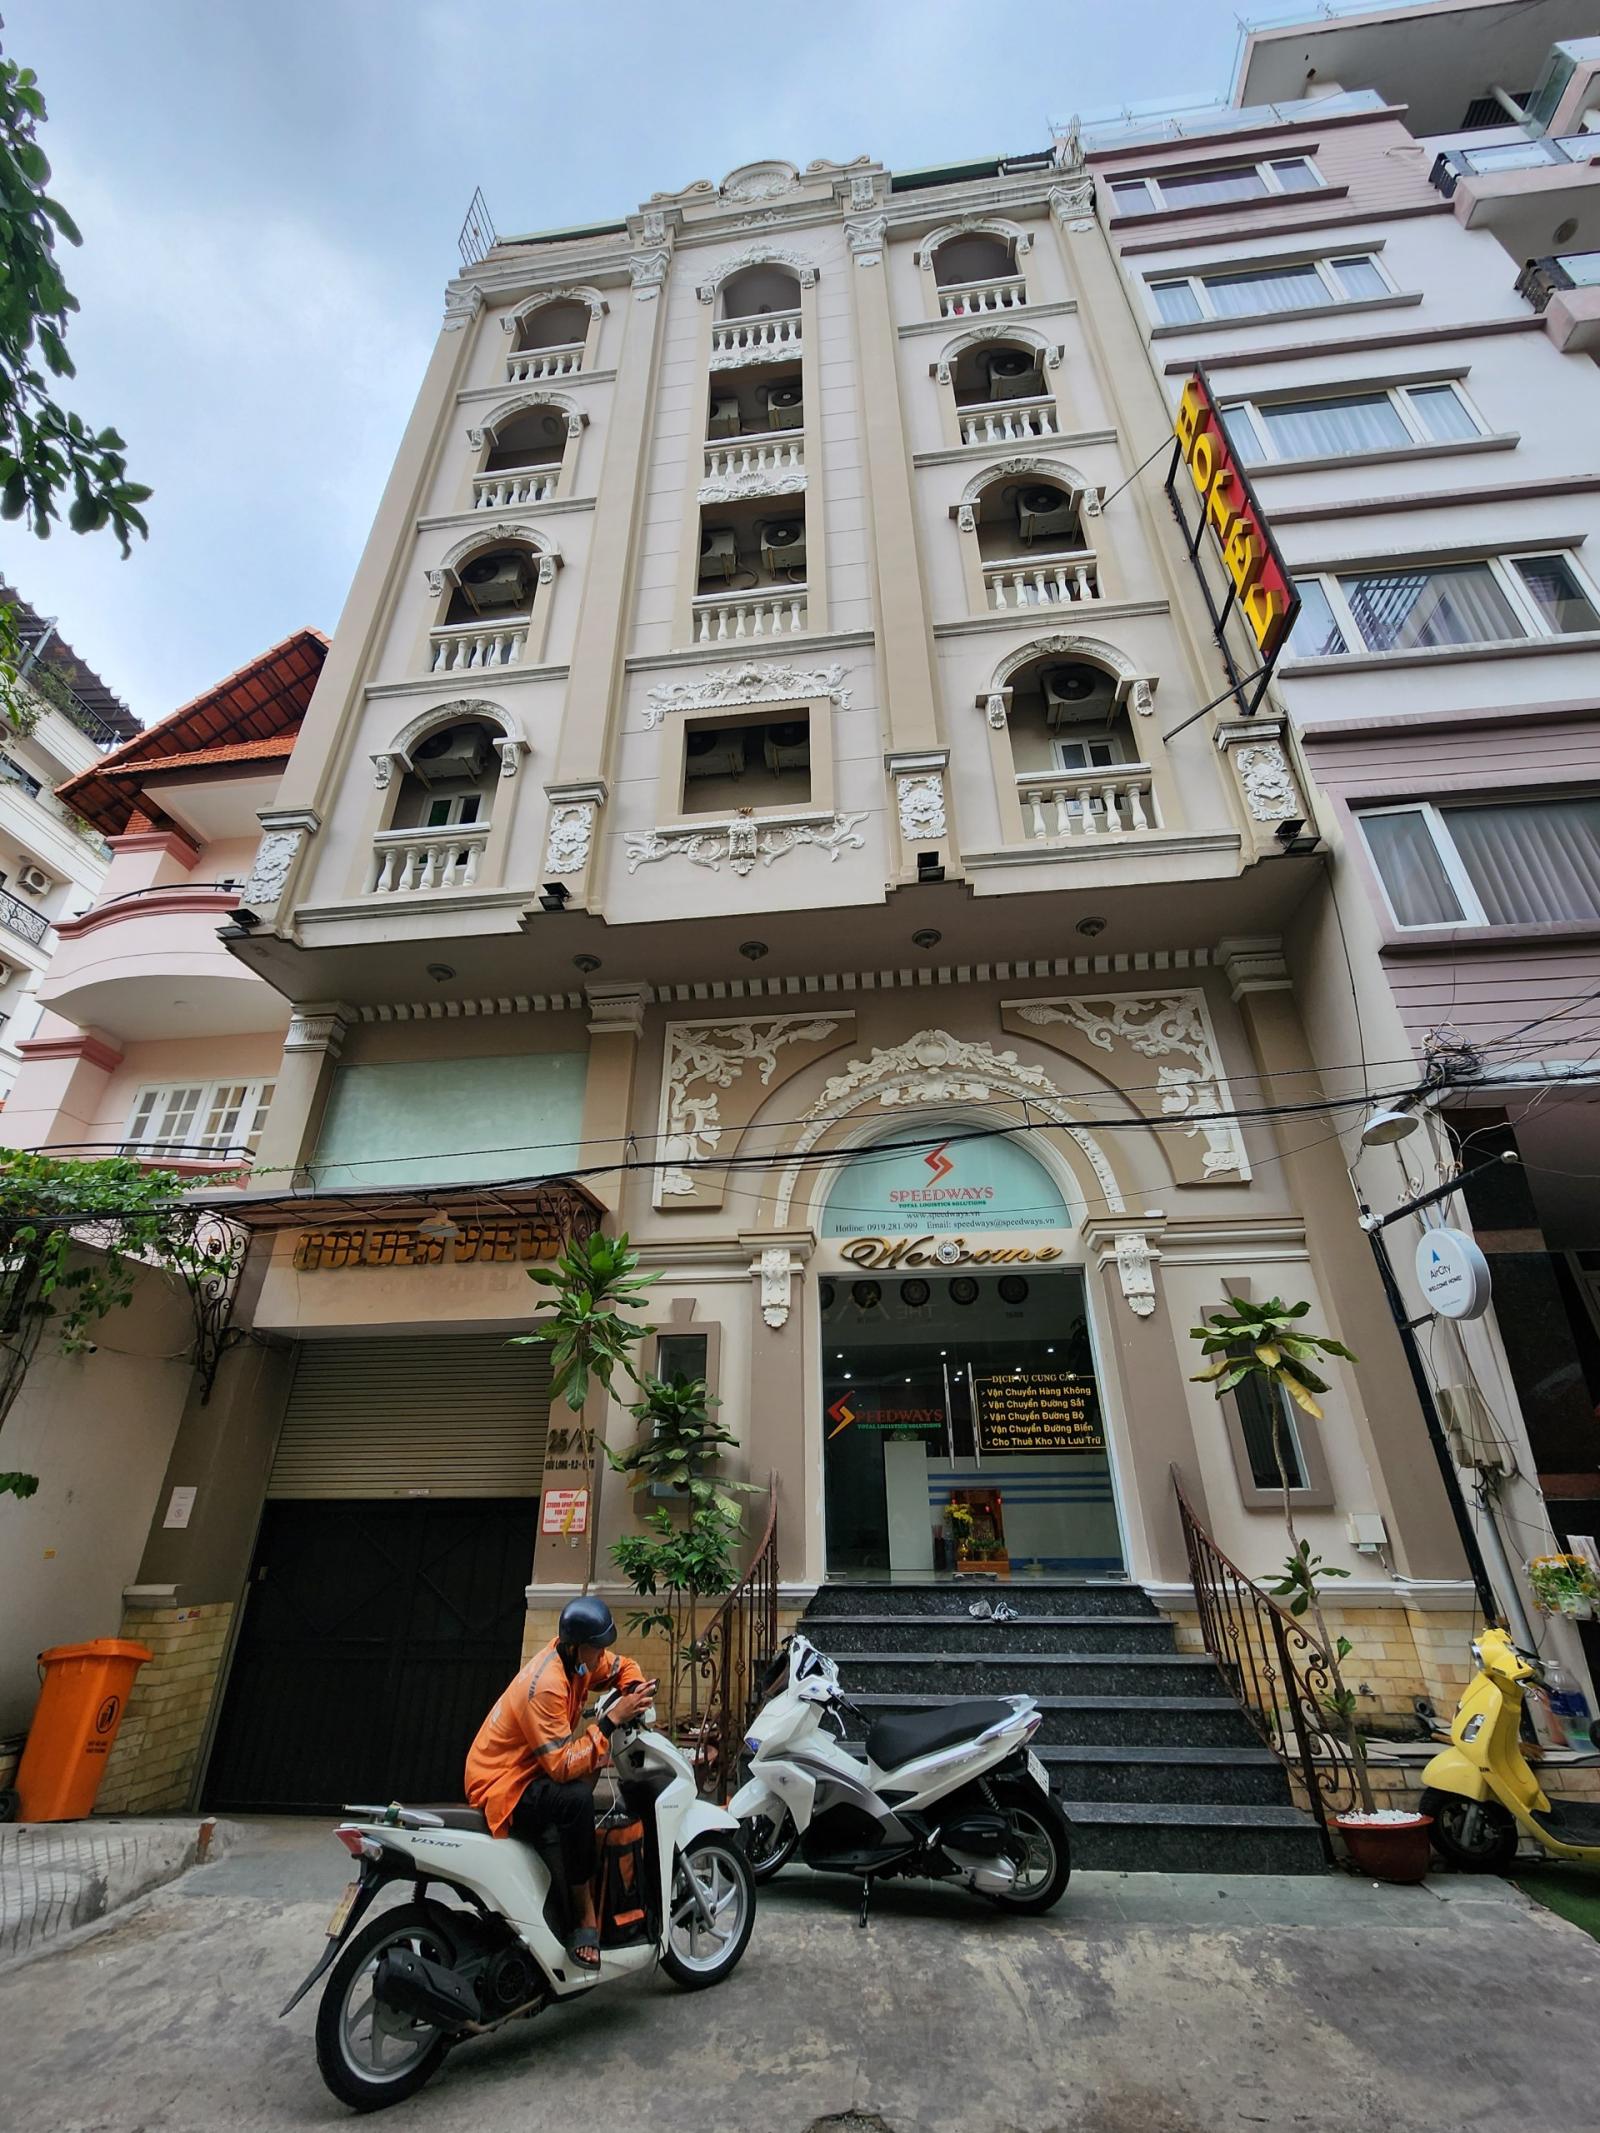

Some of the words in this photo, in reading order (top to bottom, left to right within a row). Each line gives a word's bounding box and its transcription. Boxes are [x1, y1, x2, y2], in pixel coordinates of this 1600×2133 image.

[1175, 378, 1284, 651] HOTEL
[889, 1186, 994, 1202] SPEEDWAYS
[835, 1223, 864, 1233] Hotline:
[927, 1221, 951, 1229] Email:
[953, 1218, 1055, 1230] speedways@speedways.vn
[1430, 1265, 1451, 1280] AirCity
[1429, 1281, 1448, 1292] WELCOME
[1031, 1374, 1057, 1382] CUNG
[987, 1388, 1003, 1398] Vận
[1005, 1386, 1037, 1397] Chuyển
[1039, 1387, 1061, 1396] Hàng
[1063, 1386, 1091, 1396] Không
[989, 1400, 1005, 1410] Vận
[1007, 1398, 1039, 1409] Chuyển
[990, 1412, 1006, 1422] Vận
[1008, 1410, 1040, 1422] Chuyển
[1072, 1411, 1085, 1420] Bộ
[991, 1424, 1008, 1435] Vận
[1009, 1422, 1042, 1434] Chuyển
[992, 1437, 1010, 1446] Cho
[1011, 1437, 1033, 1446] Thuê
[1035, 1436, 1053, 1445] Kho
[1055, 1436, 1066, 1445] Và
[411, 1836, 463, 1848] VISION
